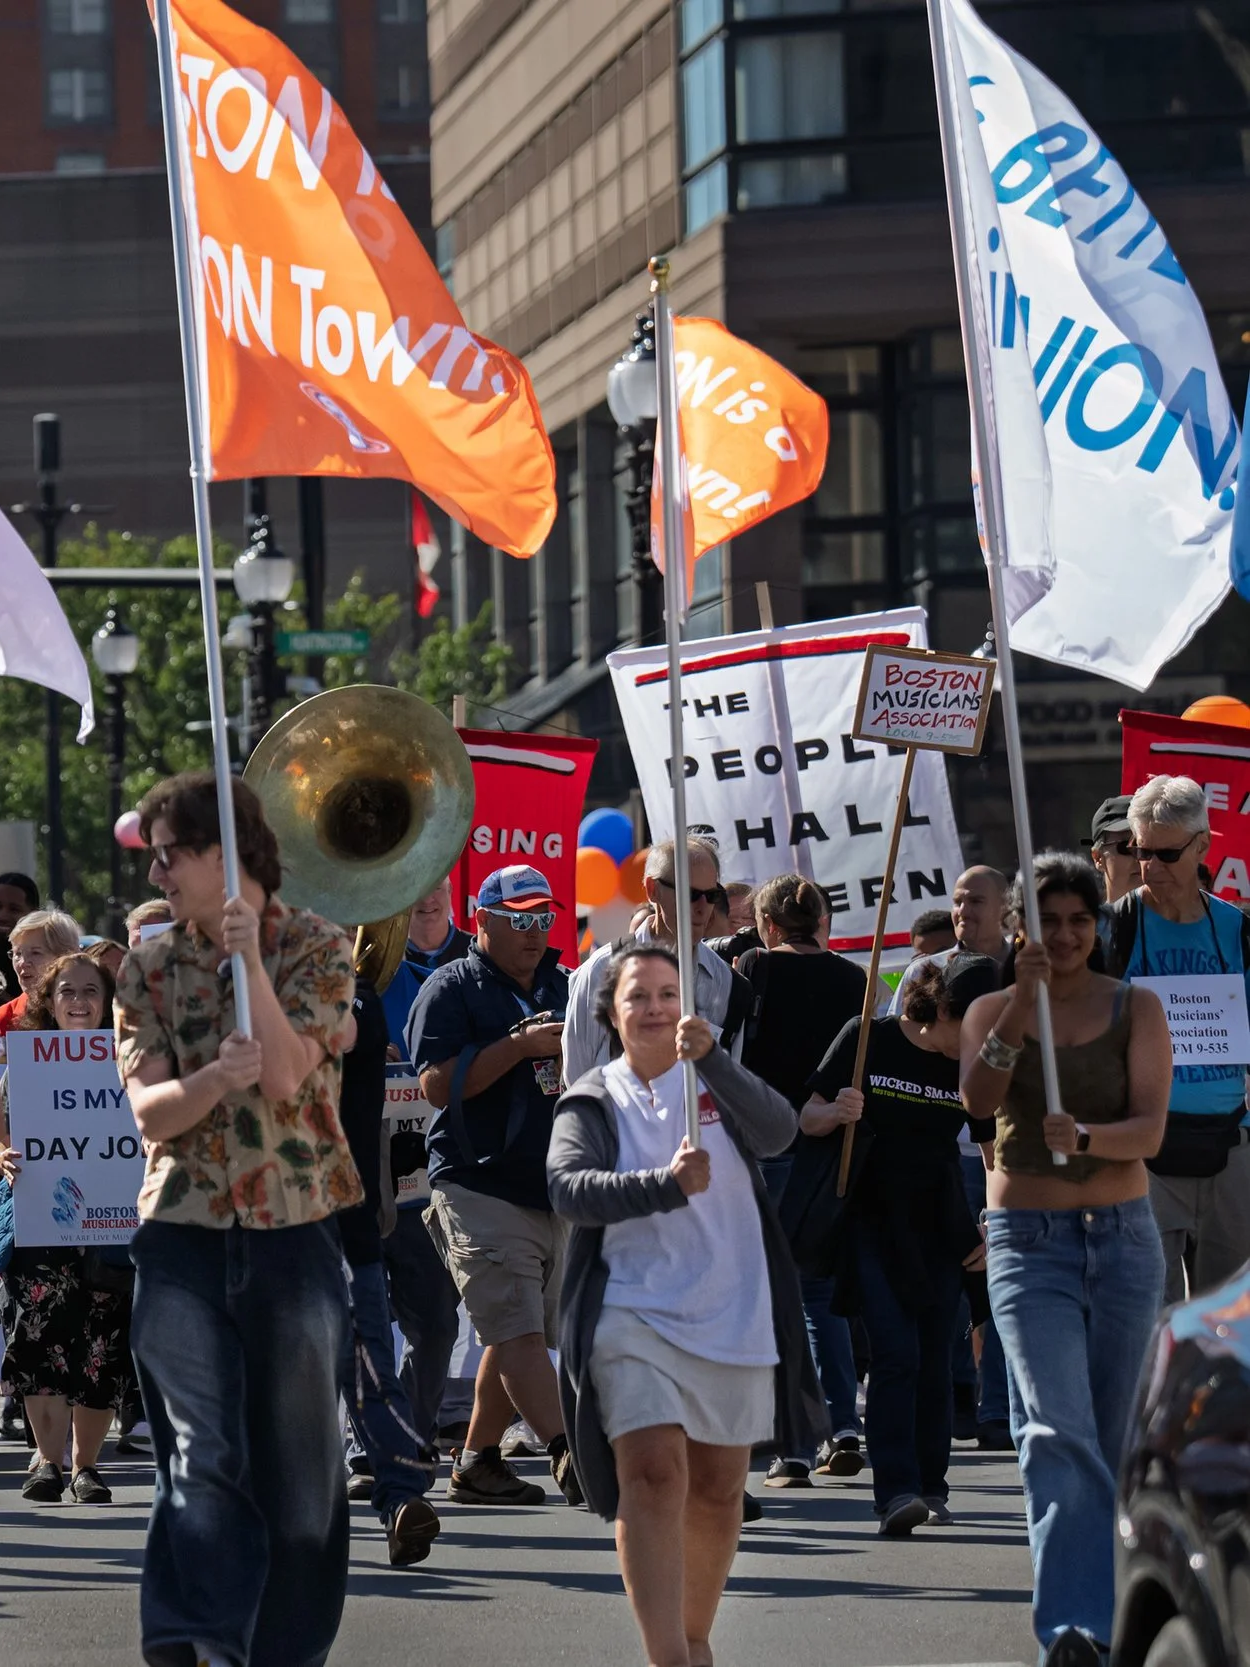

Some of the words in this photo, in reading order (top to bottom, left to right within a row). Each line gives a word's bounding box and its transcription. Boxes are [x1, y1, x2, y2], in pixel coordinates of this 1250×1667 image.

[712, 381, 769, 424] is
[885, 664, 982, 691] BOSTON
[873, 689, 982, 710] MUSICIANS
[871, 709, 977, 730] ASSOCIATION
[886, 728, 921, 739] LOCAL
[665, 732, 907, 788] PEOPL
[472, 825, 563, 859] SING
[1169, 993, 1211, 1004] Boston
[1170, 1026, 1228, 1037] ssociation
[33, 1036, 117, 1062] MUSI
[1172, 1044, 1193, 1054] FM
[1197, 1043, 1229, 1054] 9-535
[870, 1075, 922, 1094] WICKED
[872, 1087, 896, 1098] BOSTON
[53, 1089, 76, 1110] IS
[84, 1088, 126, 1110] MY
[397, 1117, 426, 1132] MY
[24, 1137, 90, 1161] DAY
[86, 1207, 138, 1219] BOSTON
[82, 1219, 139, 1229] MUSICIANS
